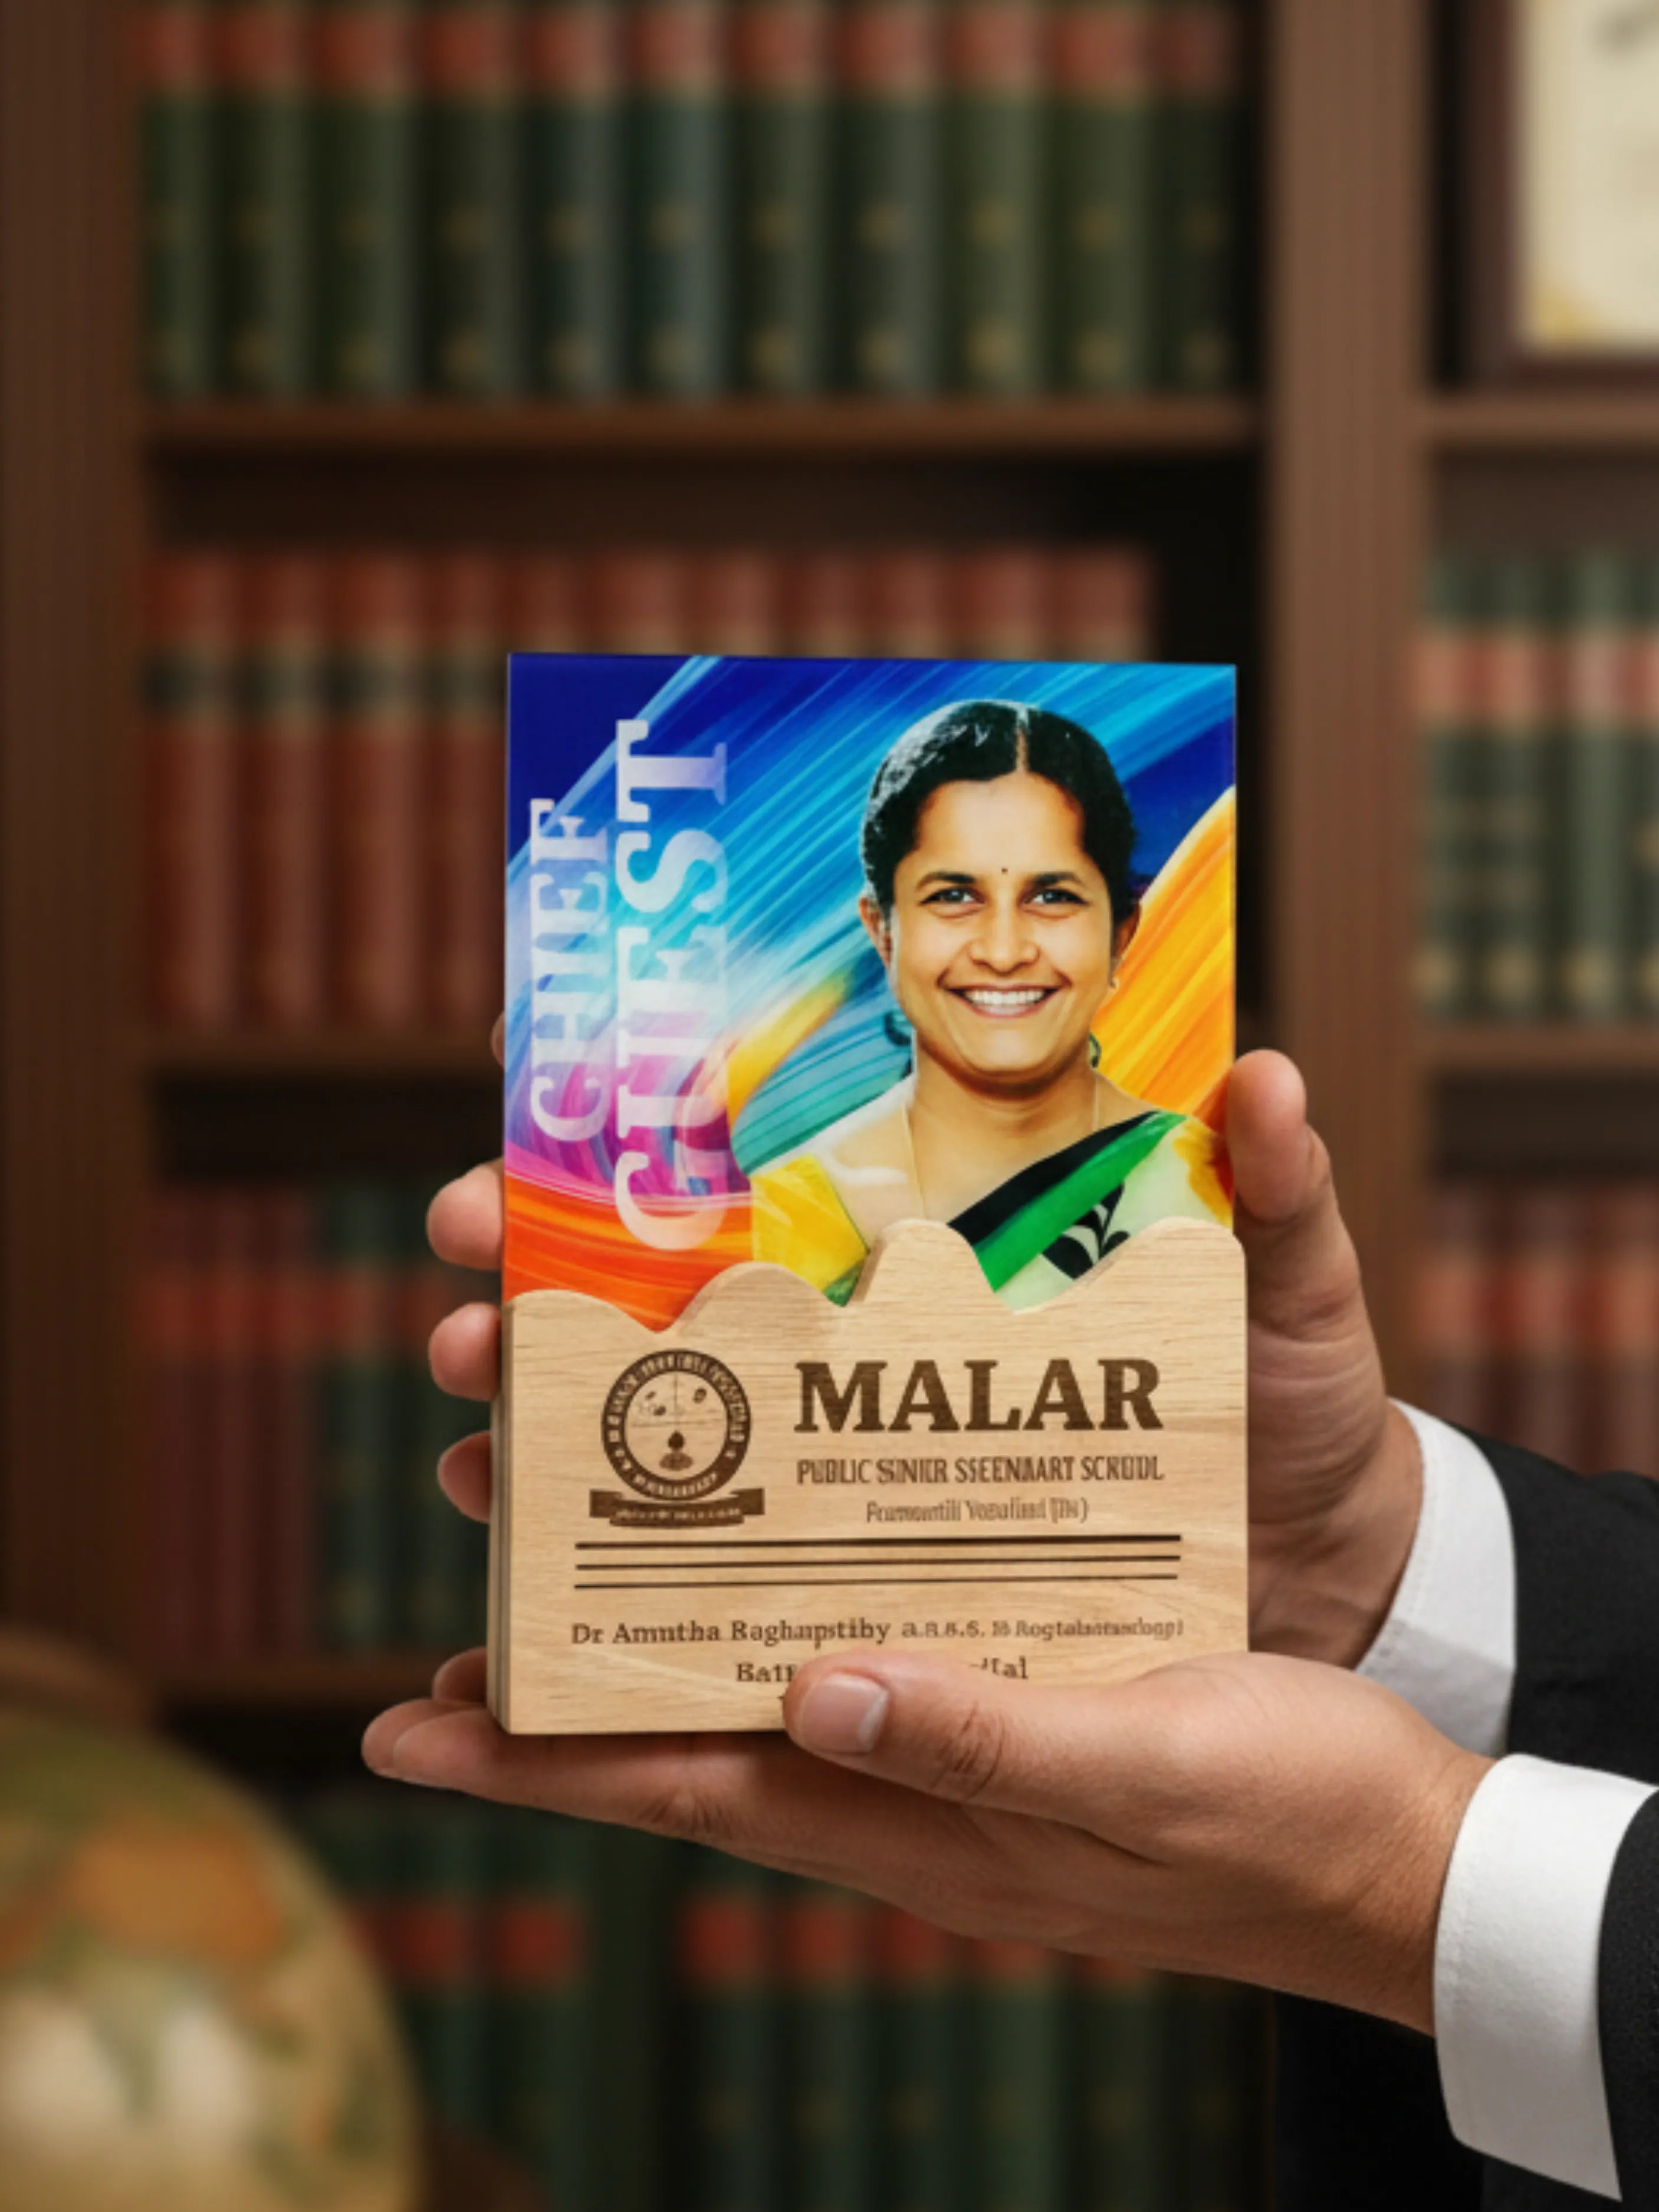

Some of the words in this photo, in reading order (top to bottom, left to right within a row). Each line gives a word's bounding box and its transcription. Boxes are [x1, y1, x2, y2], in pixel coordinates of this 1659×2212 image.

[530, 798, 609, 1143] CHIEF
[794, 1359, 1164, 1432] MALAR
[796, 1458, 873, 1485] PUBLIC
[571, 1623, 605, 1644] Dr
